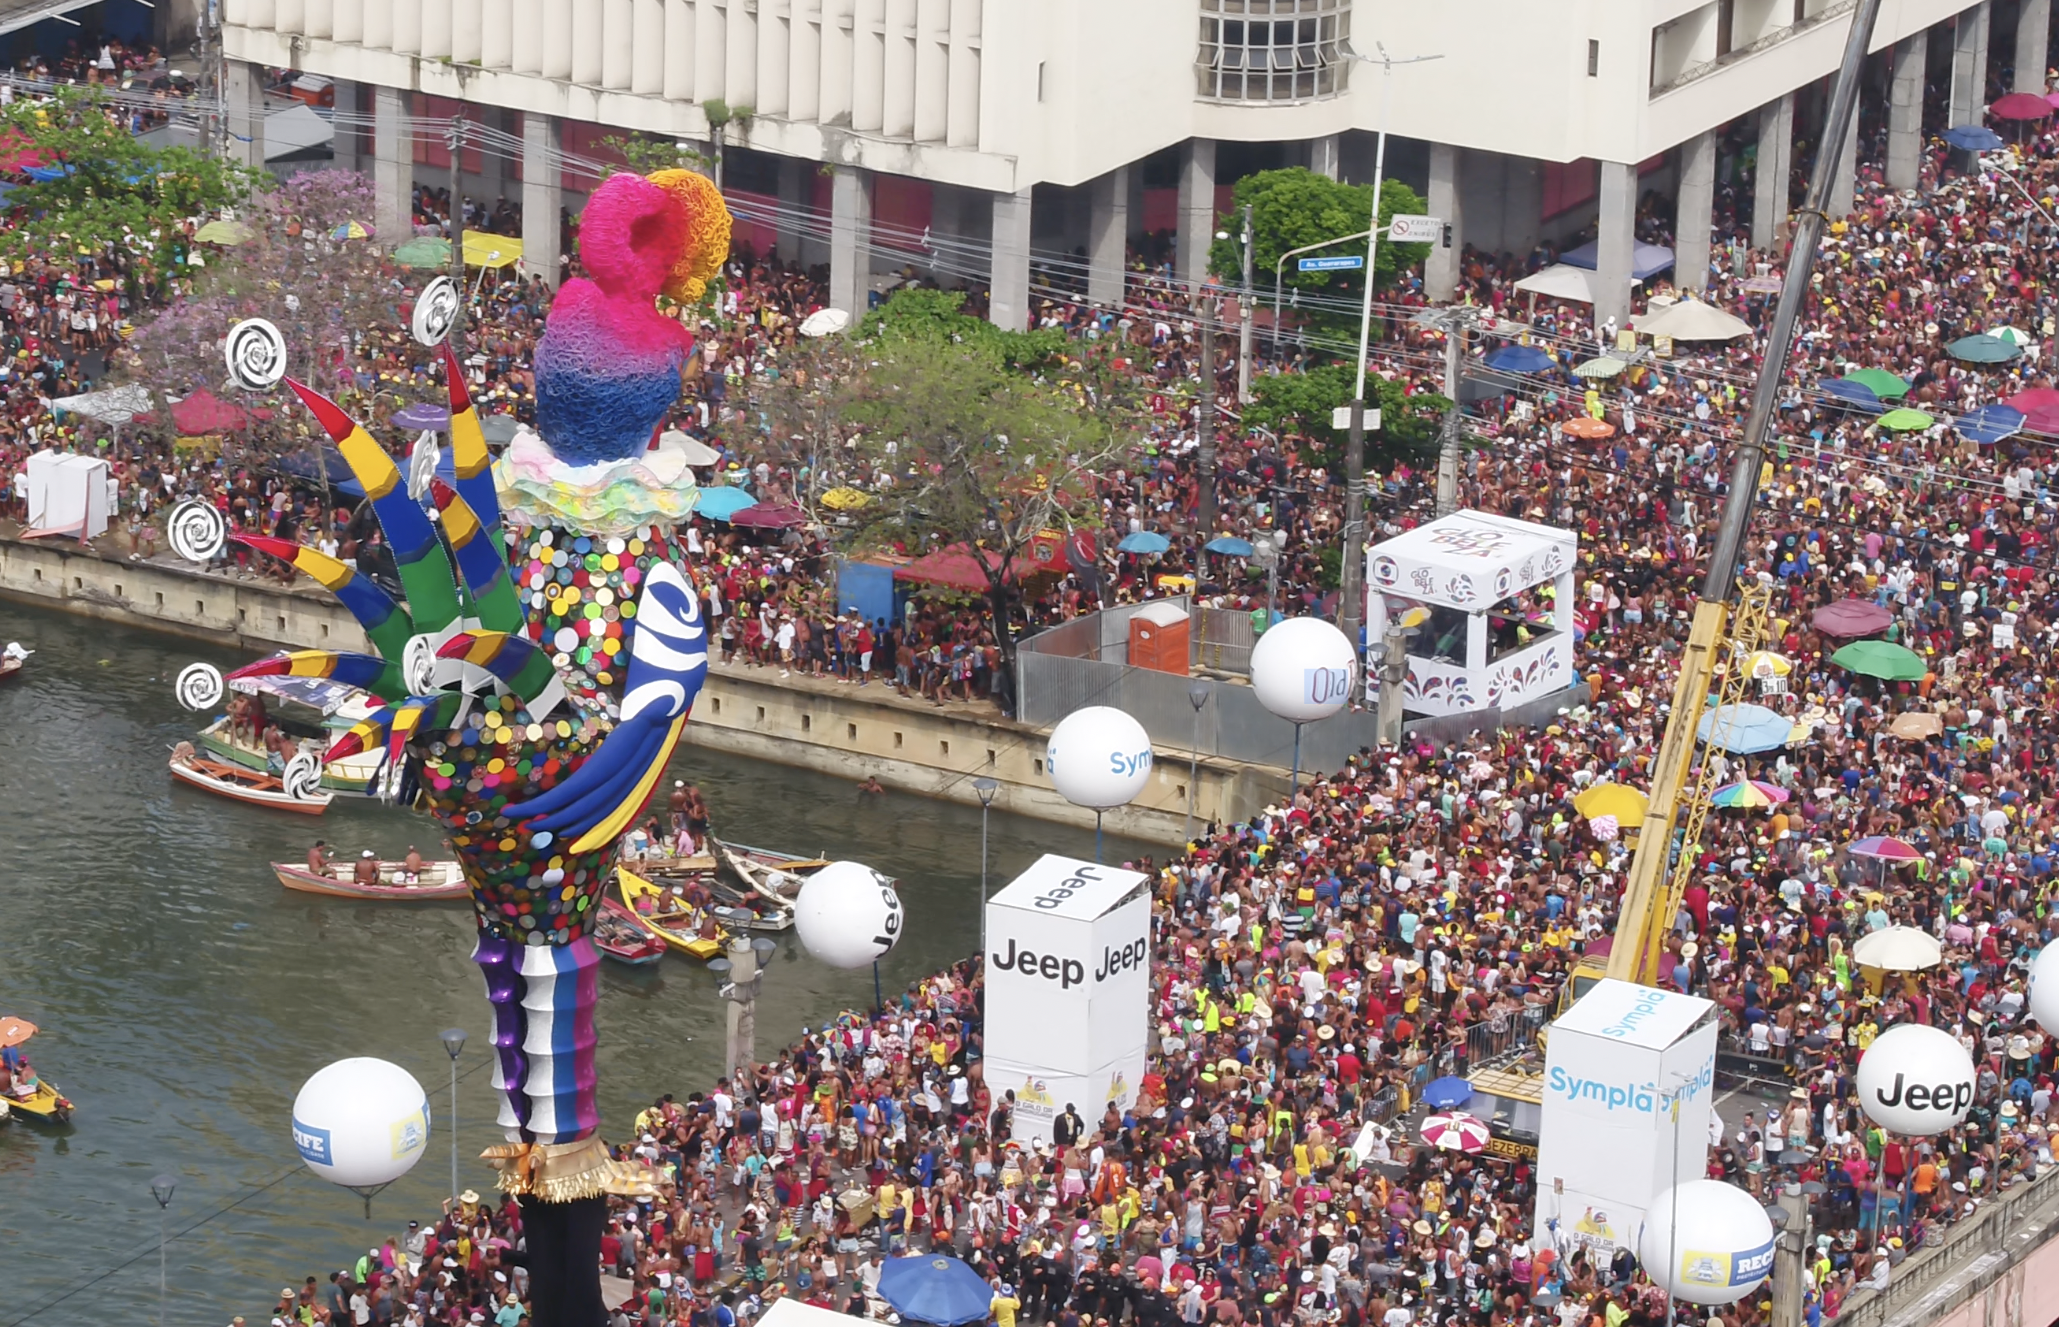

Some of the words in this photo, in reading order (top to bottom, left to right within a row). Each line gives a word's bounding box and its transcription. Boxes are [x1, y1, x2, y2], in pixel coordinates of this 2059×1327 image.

[1431, 527, 1504, 540] GLO
[1410, 568, 1429, 580] GLO
[1312, 667, 1347, 704] Old
[1034, 866, 1103, 909] Jeep
[869, 869, 900, 959] Jeep
[992, 938, 1084, 990] Jeep
[1095, 936, 1146, 983] Jeep
[1876, 1072, 1972, 1116] Jeep
[1737, 1250, 1773, 1274] REC
